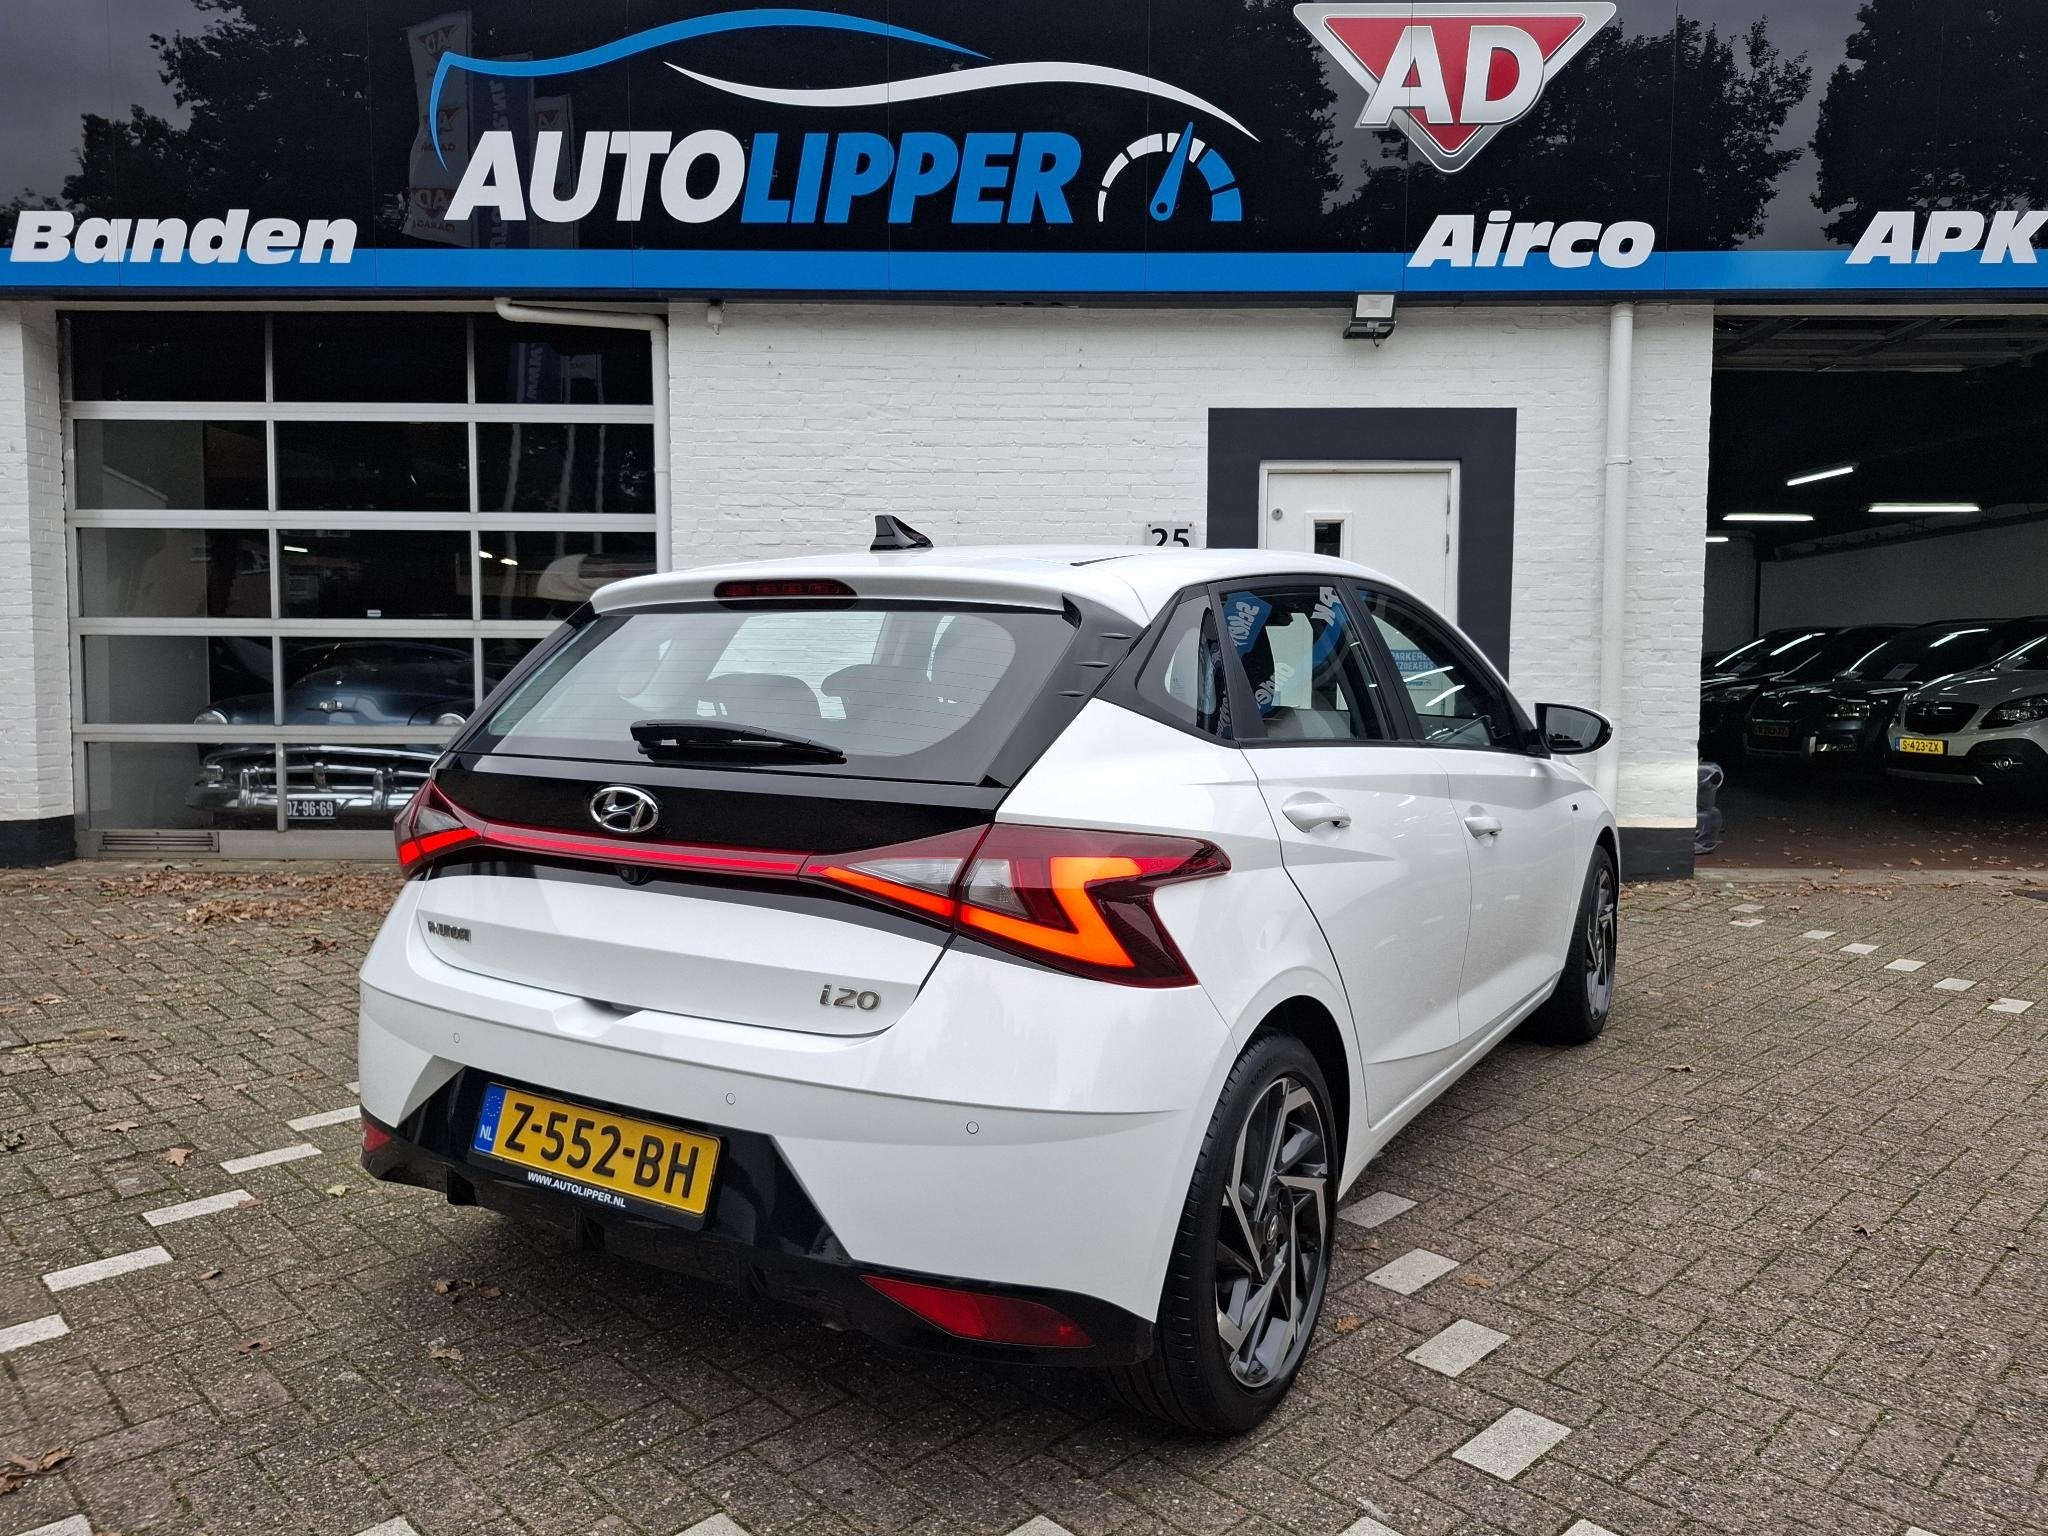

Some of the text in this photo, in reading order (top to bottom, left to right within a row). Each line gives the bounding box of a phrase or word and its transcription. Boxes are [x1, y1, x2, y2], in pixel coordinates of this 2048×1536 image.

[1356, 26, 1545, 127] AD
[444, 129, 1083, 225] AUTOLIPPER
[9, 208, 359, 265] Banden
[1406, 210, 1656, 270] Airco
[1845, 210, 2048, 265] APK
[1151, 528, 1189, 547] 25
[1902, 738, 1940, 754] S-423-ZX
[820, 984, 881, 1010] i20
[480, 1125, 493, 1142] NL
[505, 1102, 699, 1198] Z-552-BH
[527, 1171, 626, 1208] WWW.AUTOLIPPER.NL
